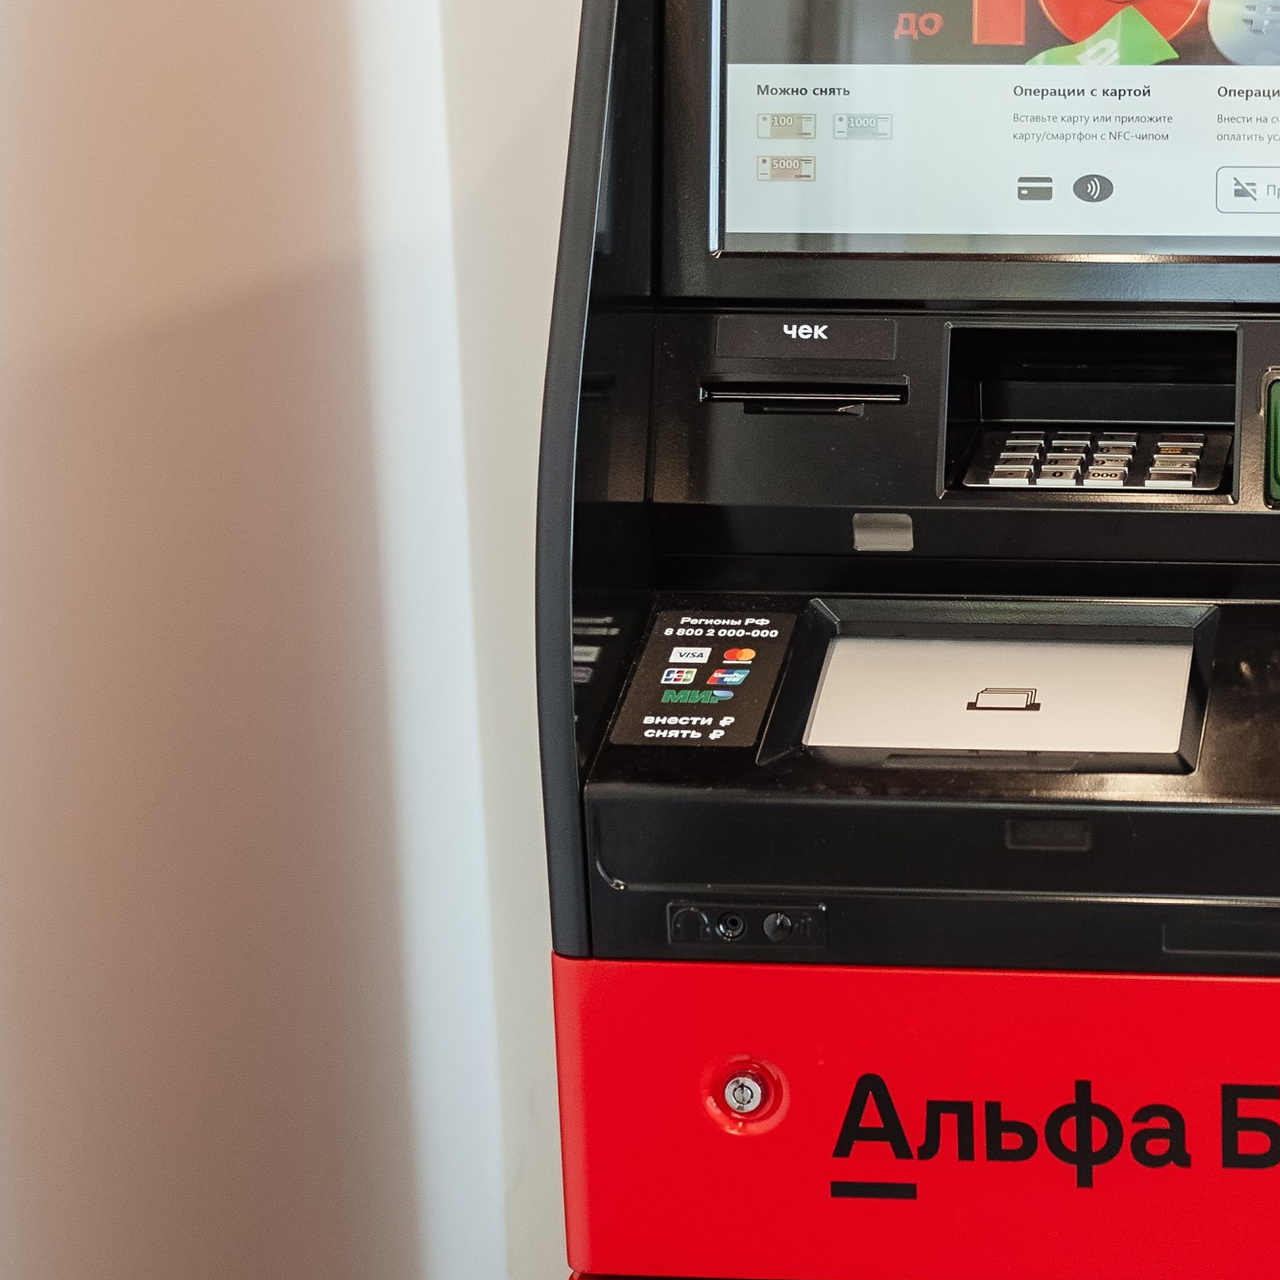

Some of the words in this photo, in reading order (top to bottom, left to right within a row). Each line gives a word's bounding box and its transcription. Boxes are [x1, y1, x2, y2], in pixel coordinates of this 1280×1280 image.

[756, 84, 808, 96] Можно
[812, 87, 851, 96] снять
[1013, 85, 1086, 100] Операции
[1090, 88, 1098, 97] с
[1102, 85, 1151, 100] картой
[771, 115, 794, 127] 100
[849, 117, 877, 128] 1000
[1012, 113, 1058, 124] Вставьте
[1060, 115, 1090, 126] карту
[1093, 115, 1112, 124] или
[1114, 115, 1173, 126] приложите
[1217, 114, 1253, 124] Внести
[1255, 116, 1268, 124] на
[1012, 131, 1098, 143] карту/смартфон
[1100, 133, 1106, 141] с
[1108, 131, 1169, 141] NFC-чипом
[1216, 132, 1265, 142] оплатить
[771, 158, 800, 170] 5000
[782, 324, 829, 339] чек
[680, 617, 742, 626] Регионы
[744, 618, 770, 626] РФ
[664, 627, 674, 636] 8
[676, 628, 704, 637] 800
[705, 628, 716, 637] 2
[717, 628, 779, 638] 000-000
[678, 651, 704, 659] VISA
[661, 689, 734, 704] МИР
[643, 729, 702, 739] снять
[830, 1072, 1192, 1190] Альфа
